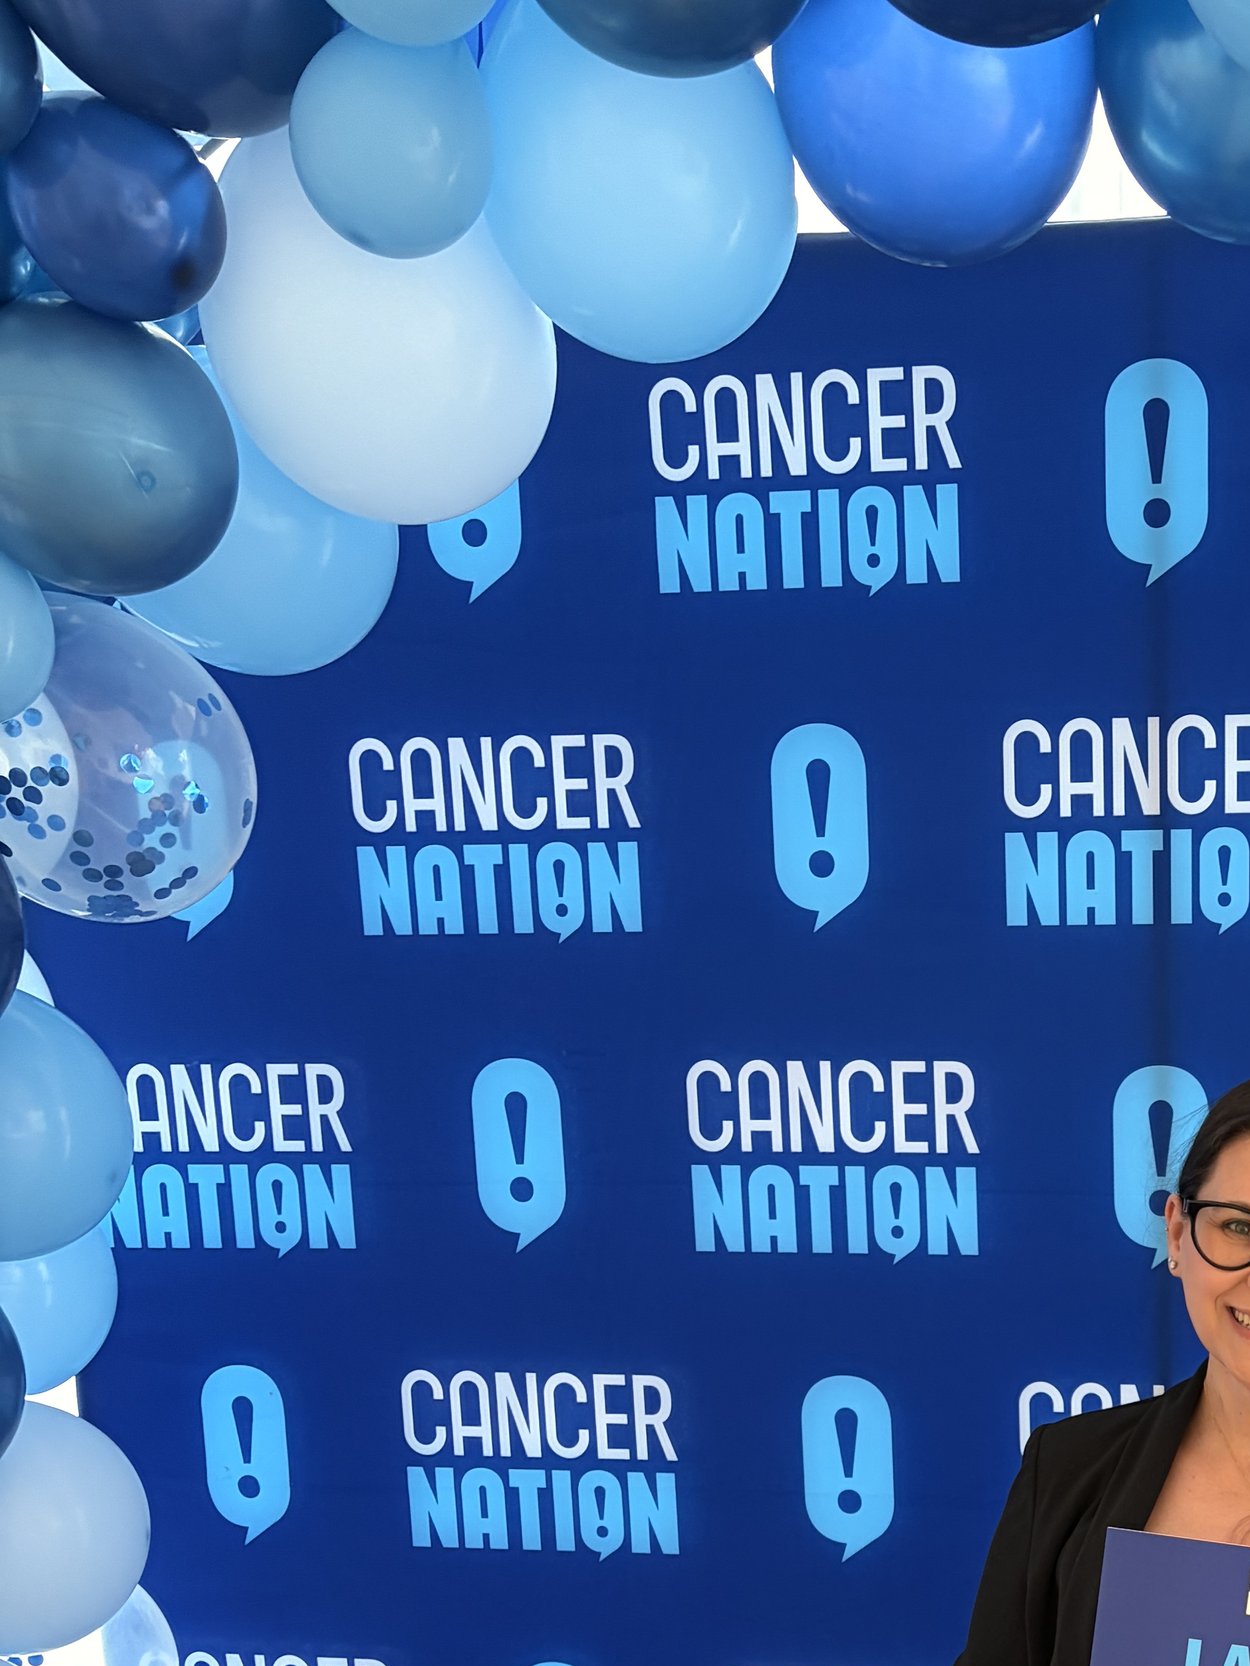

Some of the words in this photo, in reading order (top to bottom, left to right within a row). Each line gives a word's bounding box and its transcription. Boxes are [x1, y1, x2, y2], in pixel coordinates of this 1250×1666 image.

[649, 365, 962, 481] CANCER
[654, 484, 961, 597] NATION
[349, 734, 642, 833] CANCER
[356, 841, 643, 944] NATION
[126, 1062, 353, 1153] ANCER
[685, 1060, 980, 1154] CANCER
[690, 1165, 979, 1265] NATION
[401, 1370, 679, 1462] CANCER
[406, 1466, 680, 1562] NATION
